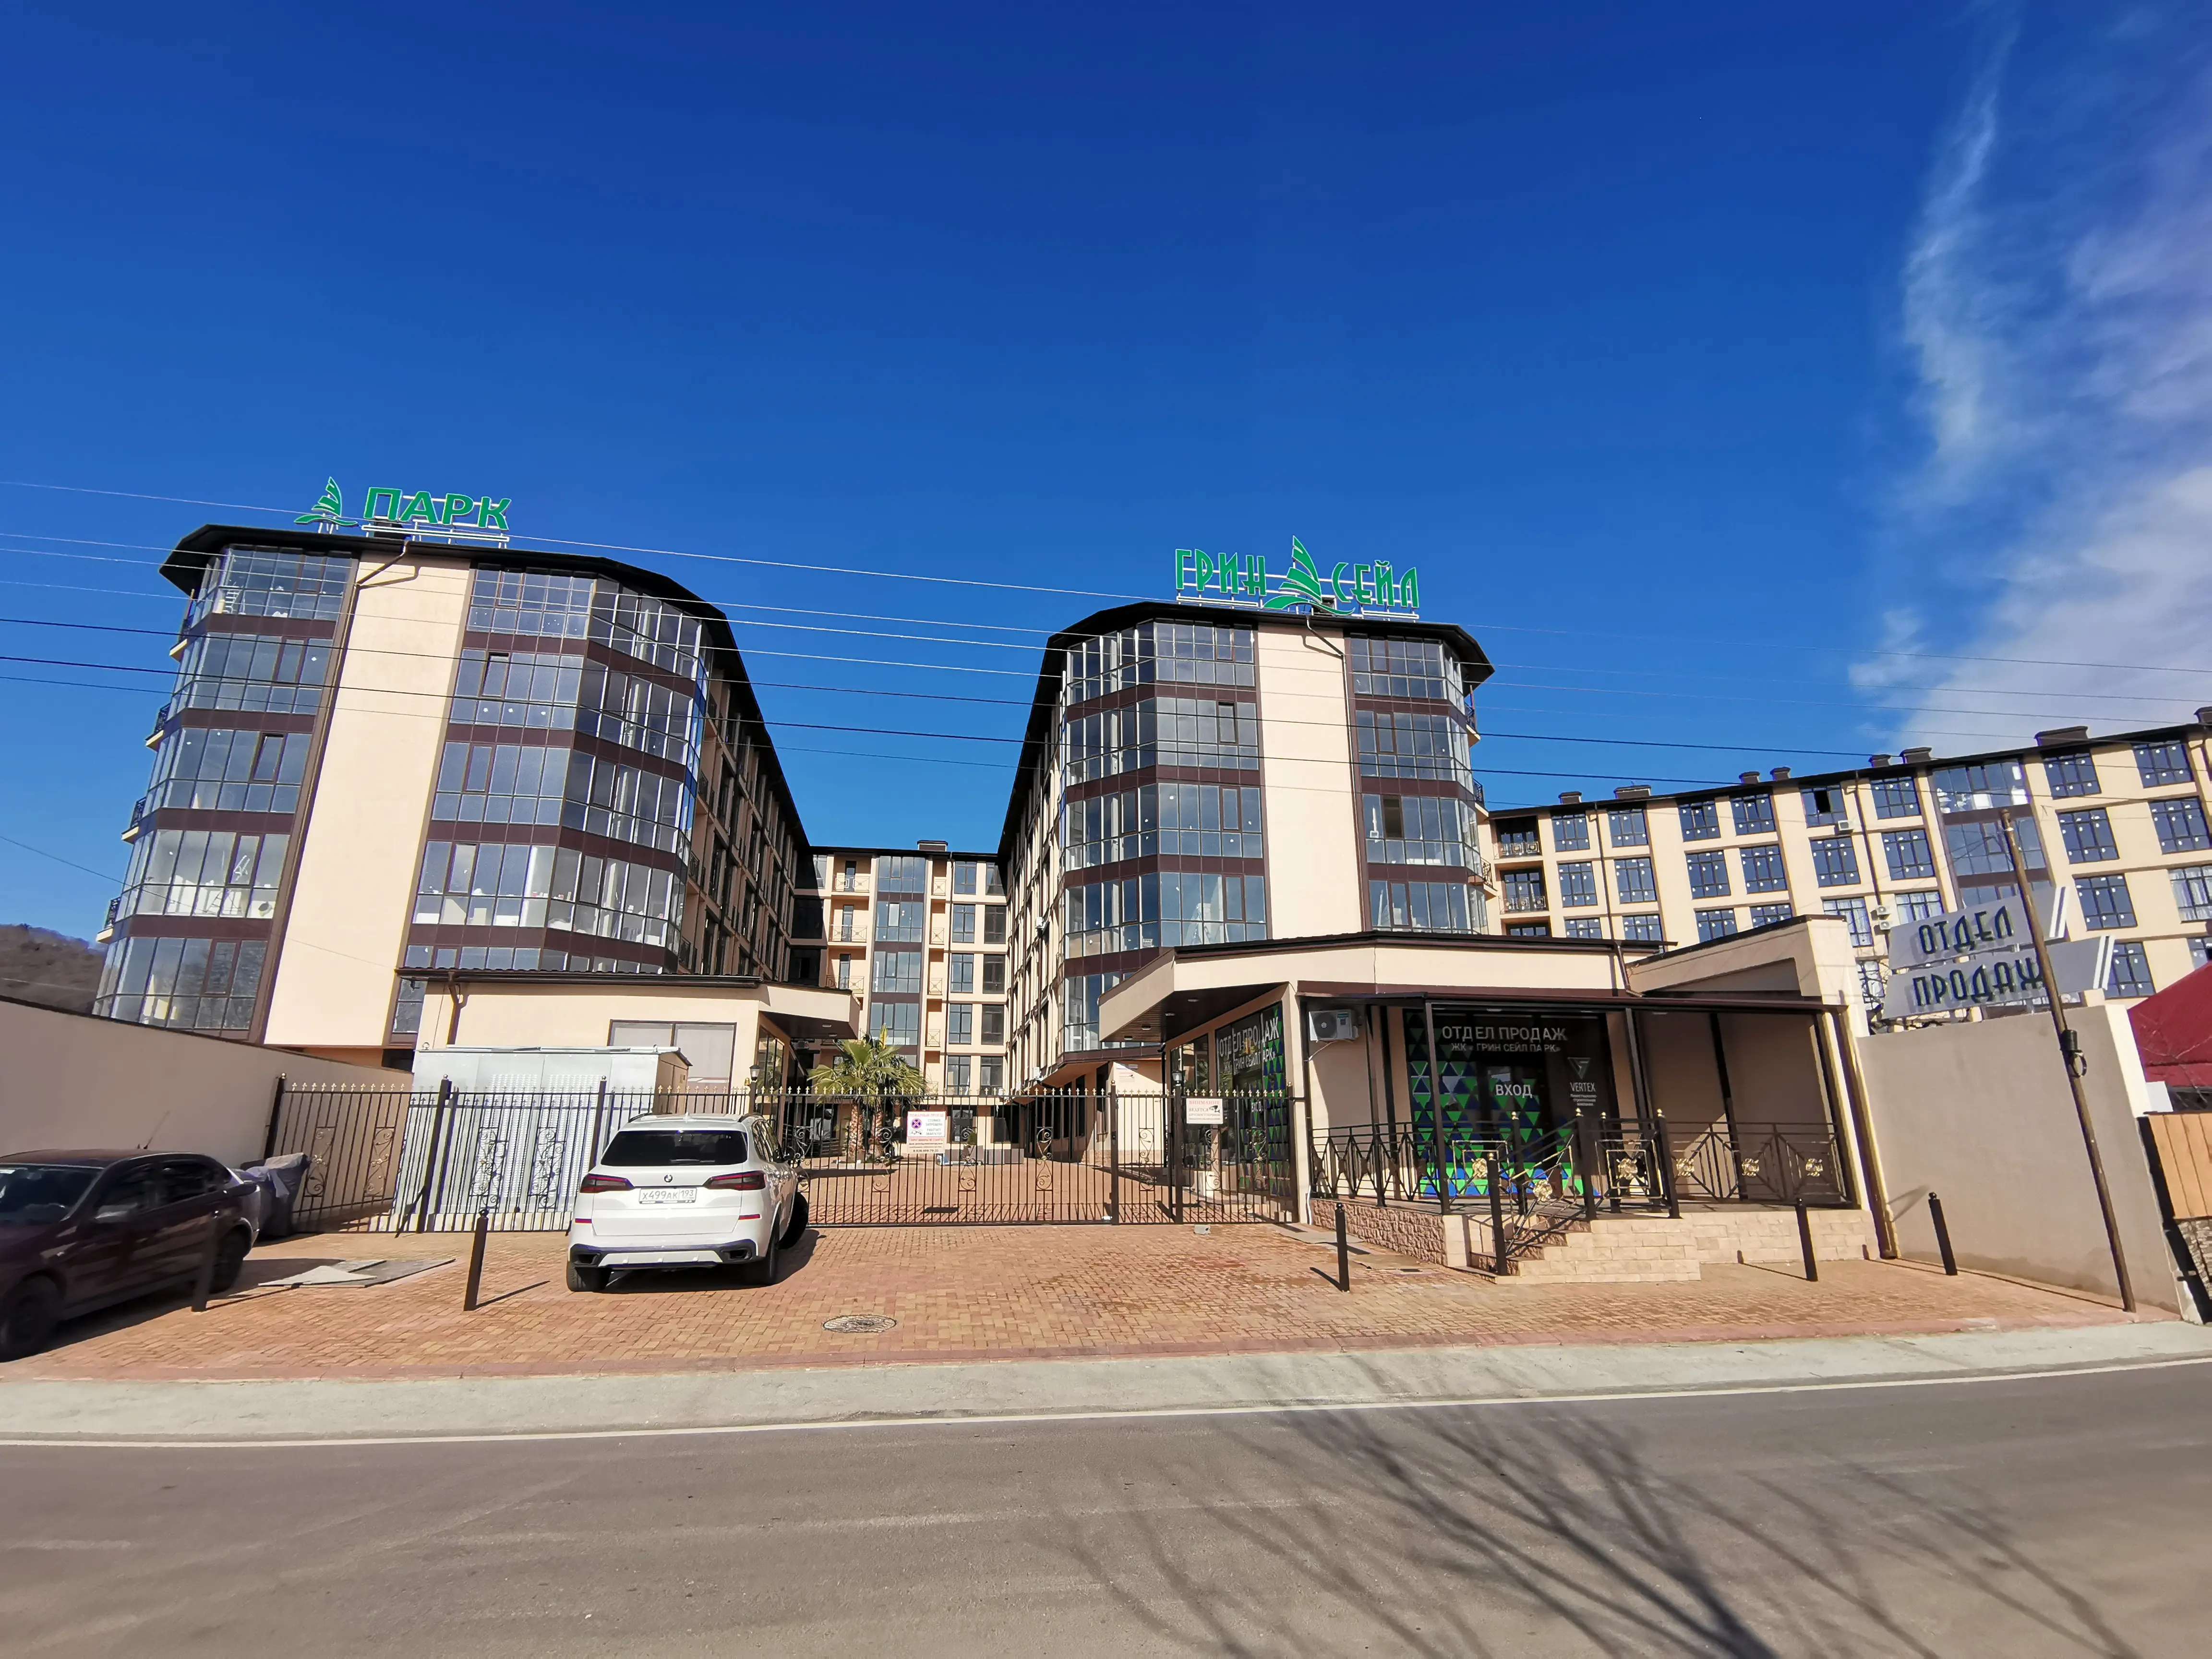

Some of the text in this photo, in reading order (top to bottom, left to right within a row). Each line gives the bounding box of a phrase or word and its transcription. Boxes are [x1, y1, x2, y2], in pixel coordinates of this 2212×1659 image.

[363, 487, 512, 530] ПАРК
[1175, 549, 1419, 608] ГРИН СЕЙЛ
[1919, 905, 2014, 954] ОТДЕЛ
[1912, 958, 2043, 1006] ПРОДАЖ
[1442, 1026, 1568, 1043] ОТДЕЛ ПРОДАЖ
[1451, 1043, 1466, 1051] ЖК
[1503, 1042, 1527, 1052] СЕЙЛ
[1496, 1084, 1532, 1098] ВХОД
[1570, 1082, 1596, 1092] VERTEX
